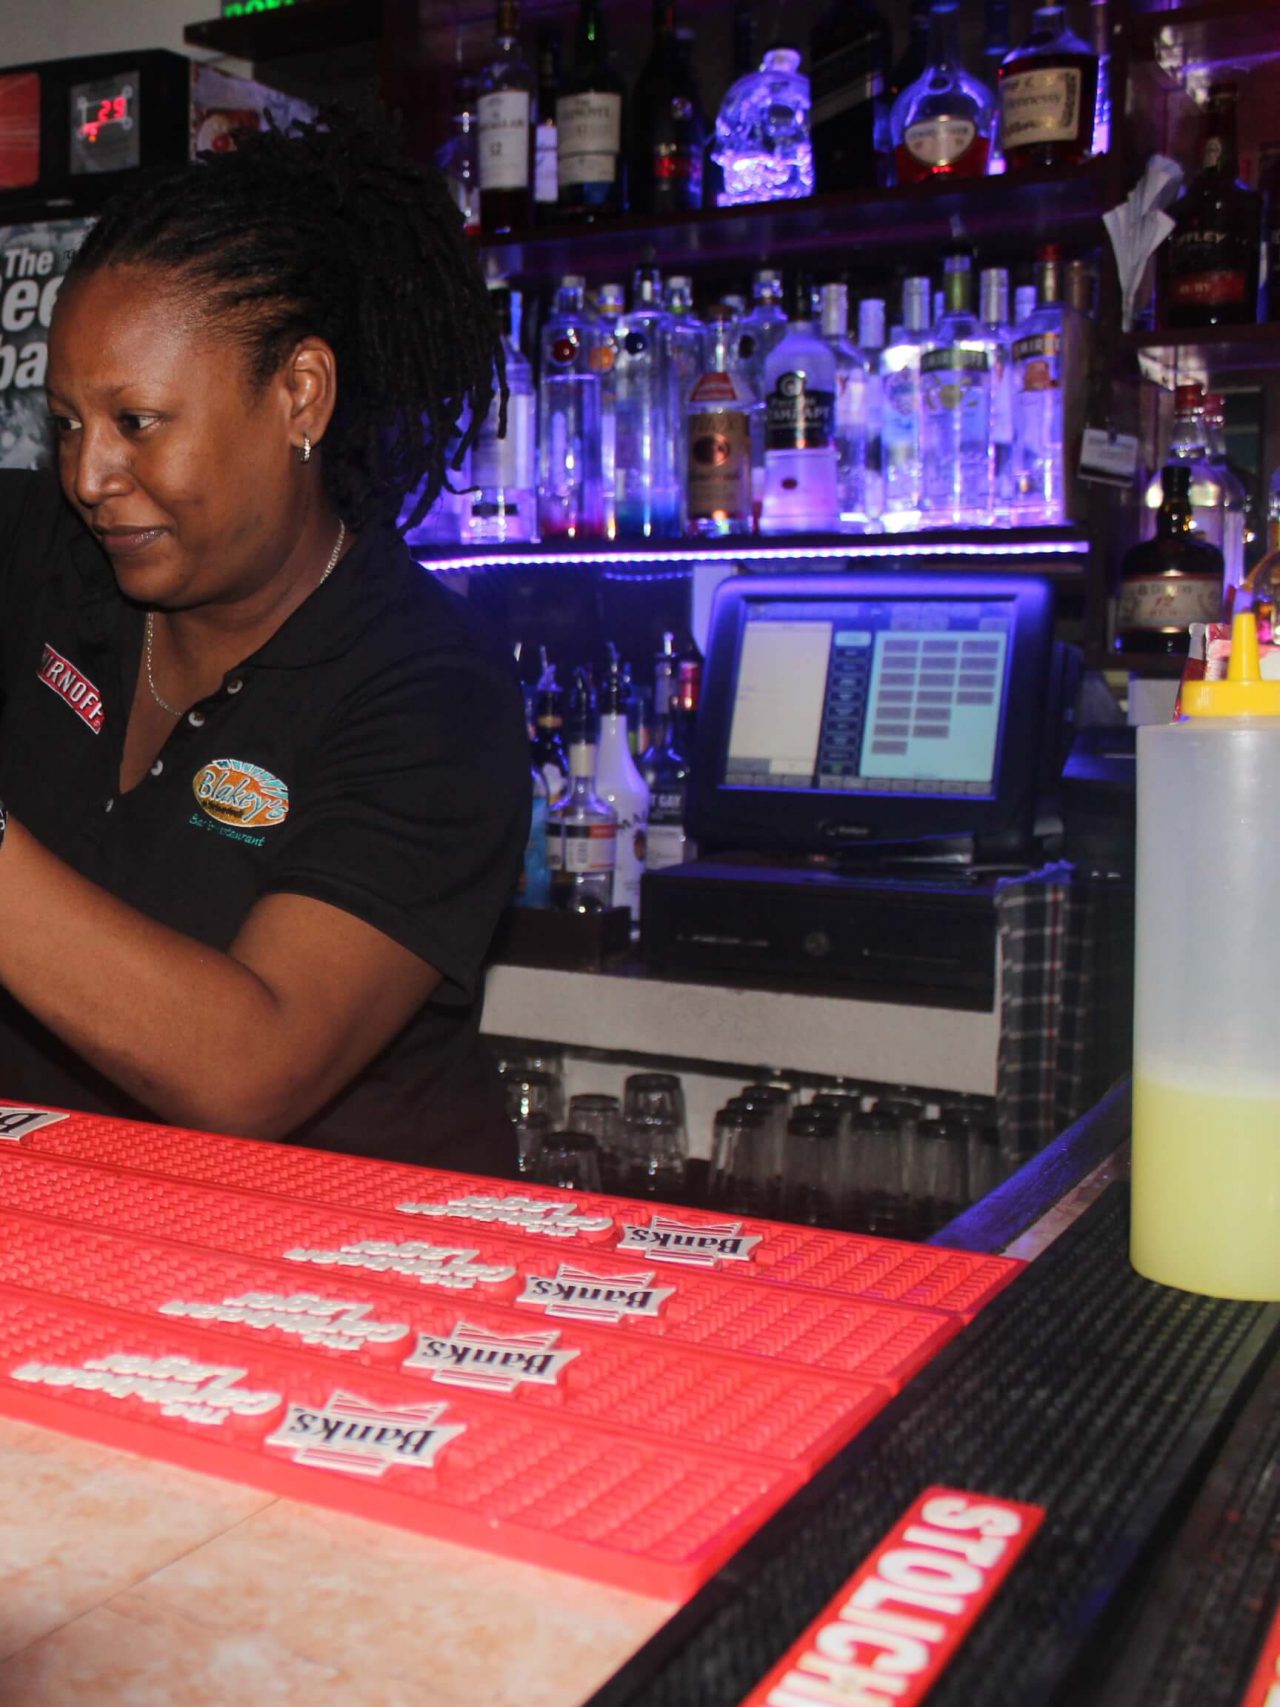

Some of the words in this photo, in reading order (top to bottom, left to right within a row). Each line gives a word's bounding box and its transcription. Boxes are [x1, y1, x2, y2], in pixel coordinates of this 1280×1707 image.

[4, 248, 54, 280] The
[199, 769, 289, 823] Blakey's
[631, 1227, 744, 1255] Banks
[531, 1279, 654, 1309] Banks
[422, 1340, 556, 1376] Banks
[290, 1412, 437, 1454] Banks
